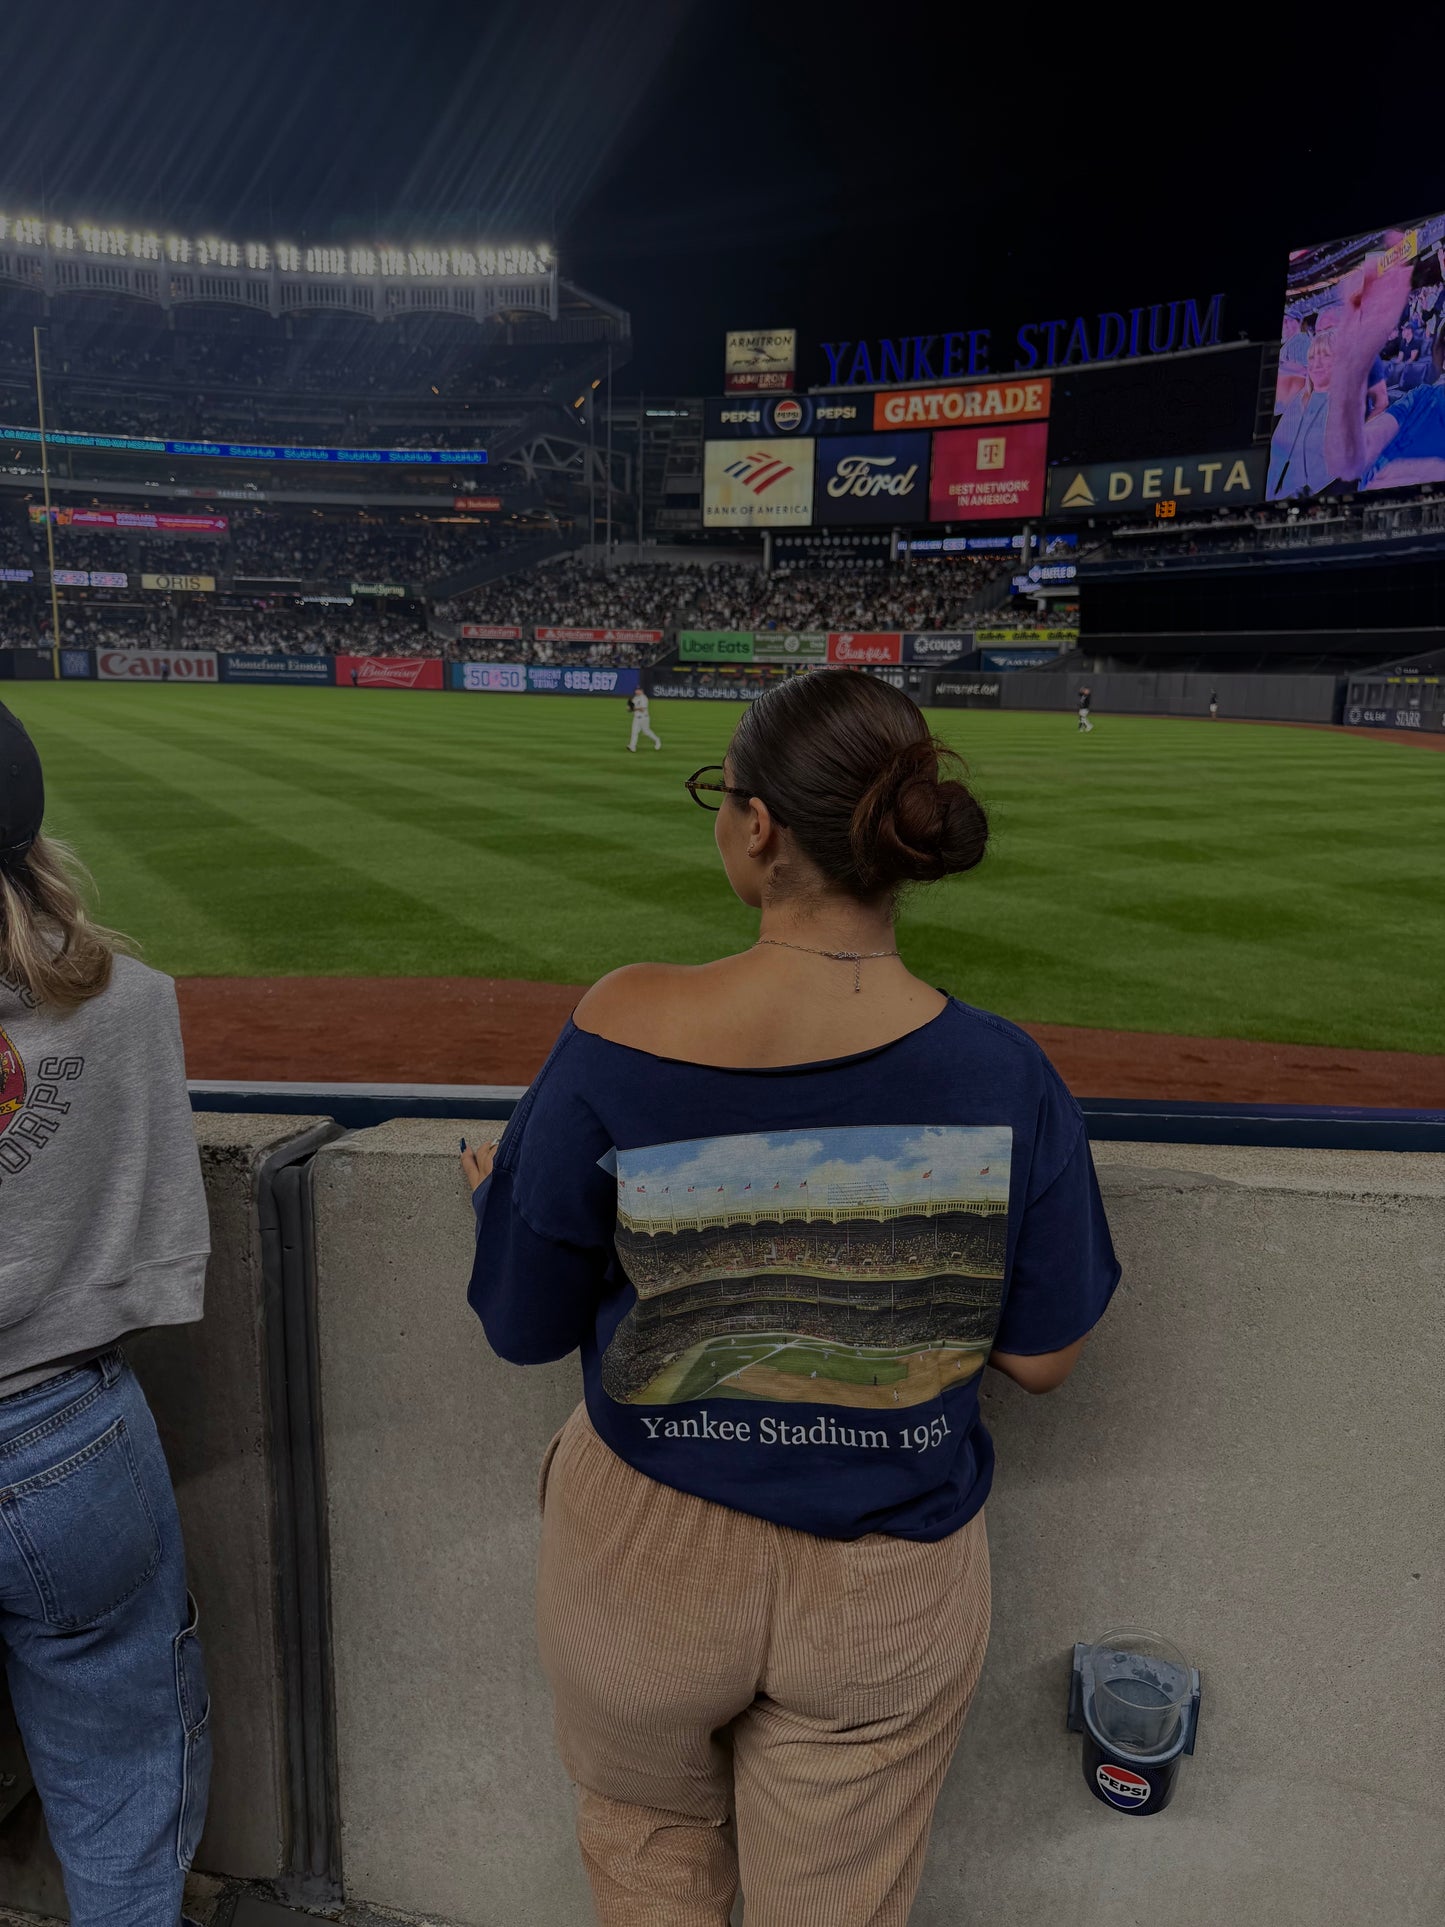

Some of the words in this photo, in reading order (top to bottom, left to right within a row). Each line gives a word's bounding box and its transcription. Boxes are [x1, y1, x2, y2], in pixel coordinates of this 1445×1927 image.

[730, 336, 793, 347] ARMITRON
[820, 328, 991, 387] YANKEE
[1013, 293, 1226, 371] STADIUM
[730, 373, 788, 385] ARMITRON
[884, 384, 1043, 423] GATORADE
[721, 410, 760, 423] PEPSI
[777, 411, 799, 420] PEPSI
[816, 406, 857, 420] PEPSI
[984, 444, 999, 464] T
[827, 456, 919, 498] Ford
[1108, 460, 1251, 501] DELTA
[949, 483, 975, 496] BEST
[976, 480, 1030, 494] NETWORK
[958, 497, 969, 506] IN
[970, 493, 1019, 506] AMERICA
[707, 506, 737, 515] BANK
[740, 506, 755, 515] OF
[757, 505, 809, 515] AMERICA
[156, 575, 201, 590] ORIS
[682, 640, 715, 654] Uber
[718, 640, 750, 654] Eats
[928, 638, 963, 653] coupa
[100, 652, 215, 678] Canon
[228, 659, 286, 671] Montefiore
[288, 660, 328, 672] Einstein
[362, 666, 419, 678] Budweiser
[471, 670, 490, 687] 50
[501, 671, 520, 688] 50
[653, 685, 695, 697] StubHub
[697, 686, 738, 698] StubHub
[739, 687, 766, 699] Stub
[1395, 710, 1421, 728] STARR
[0, 1057, 84, 1175] ORPS
[640, 1411, 751, 1443] Yankee
[759, 1416, 890, 1449] Stadium
[900, 1413, 952, 1453] 1951
[1099, 1772, 1147, 1797] PEPSI
